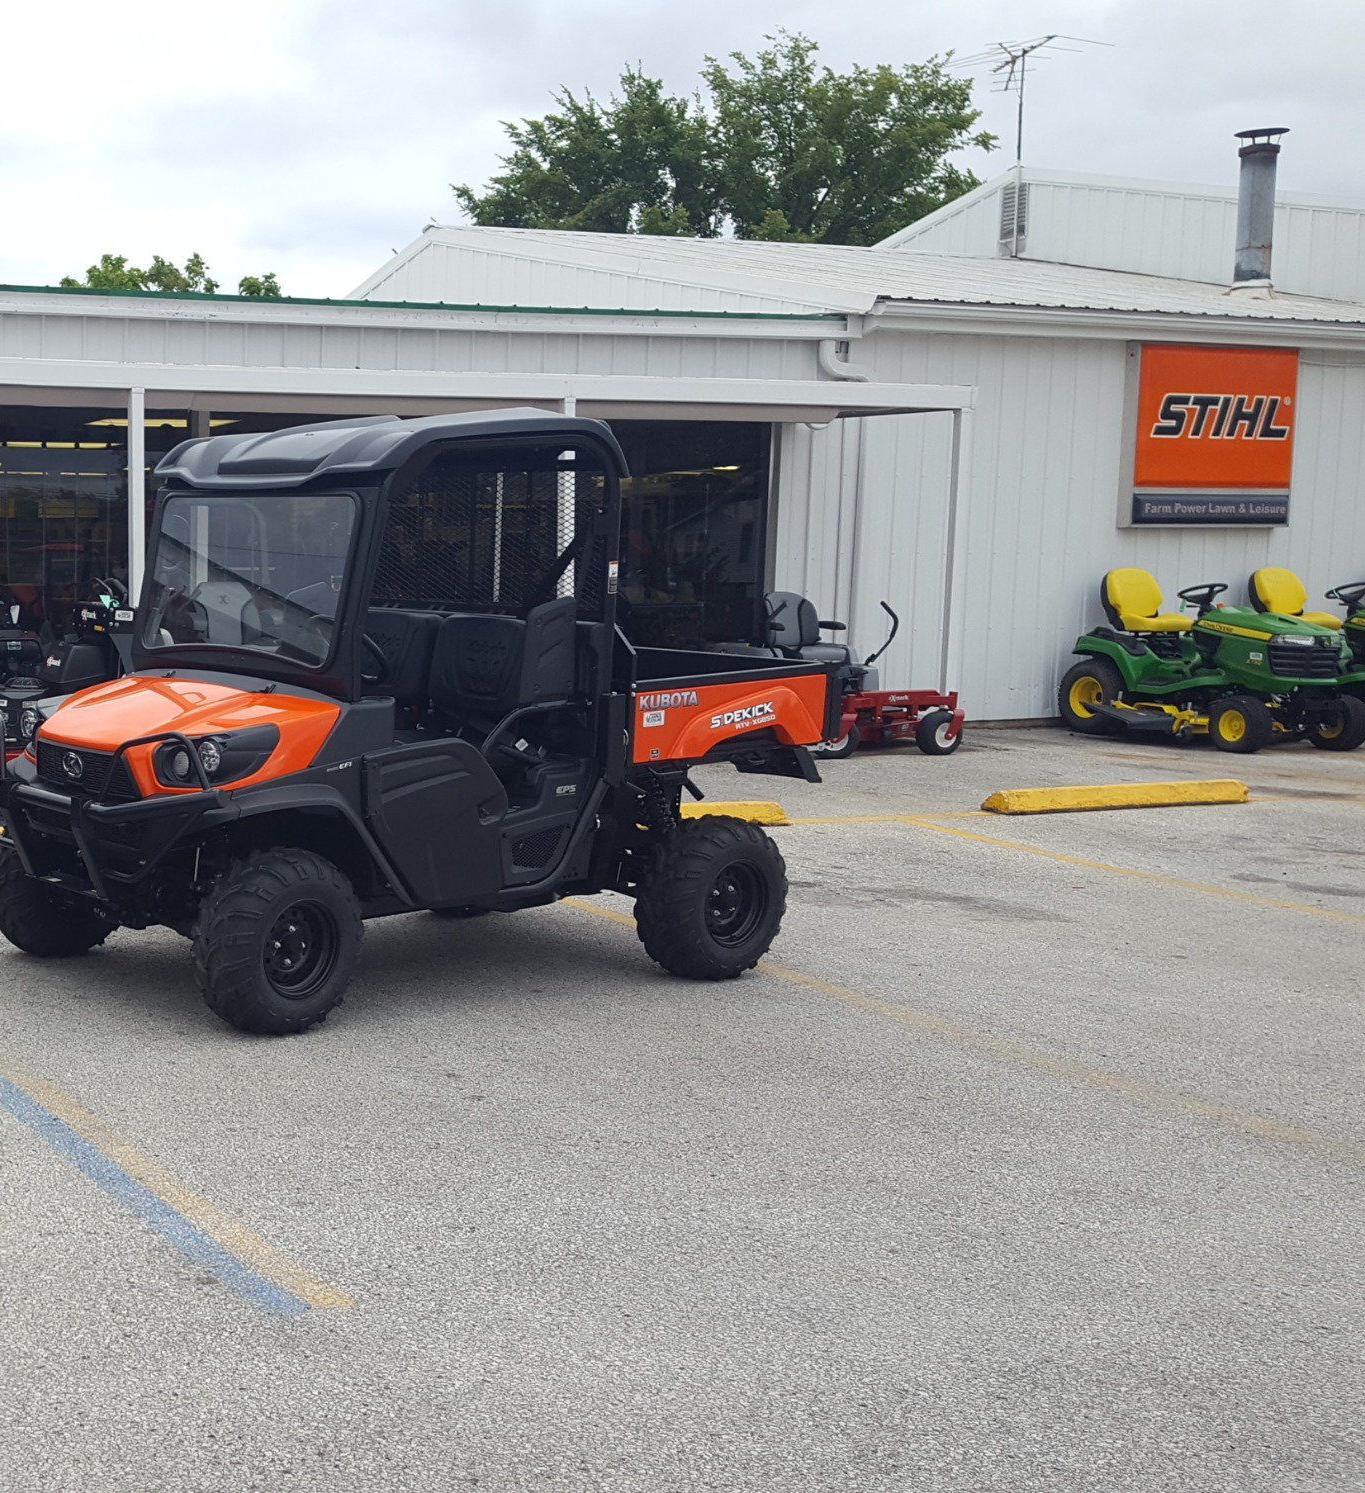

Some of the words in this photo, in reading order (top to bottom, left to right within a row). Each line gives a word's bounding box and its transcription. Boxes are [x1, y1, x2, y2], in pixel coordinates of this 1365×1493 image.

[1150, 392, 1290, 440] STIHL
[1144, 502, 1172, 514] Farm
[1174, 502, 1207, 514] Power
[1208, 502, 1237, 514] Lawn
[1238, 503, 1247, 514] &
[1249, 503, 1287, 515] Leisure
[639, 690, 699, 711] KUBOTA
[710, 702, 774, 729] SIDEKICK
[734, 714, 776, 731] RTV-XG850
[339, 761, 353, 770] EFI
[555, 784, 577, 794] EPS
